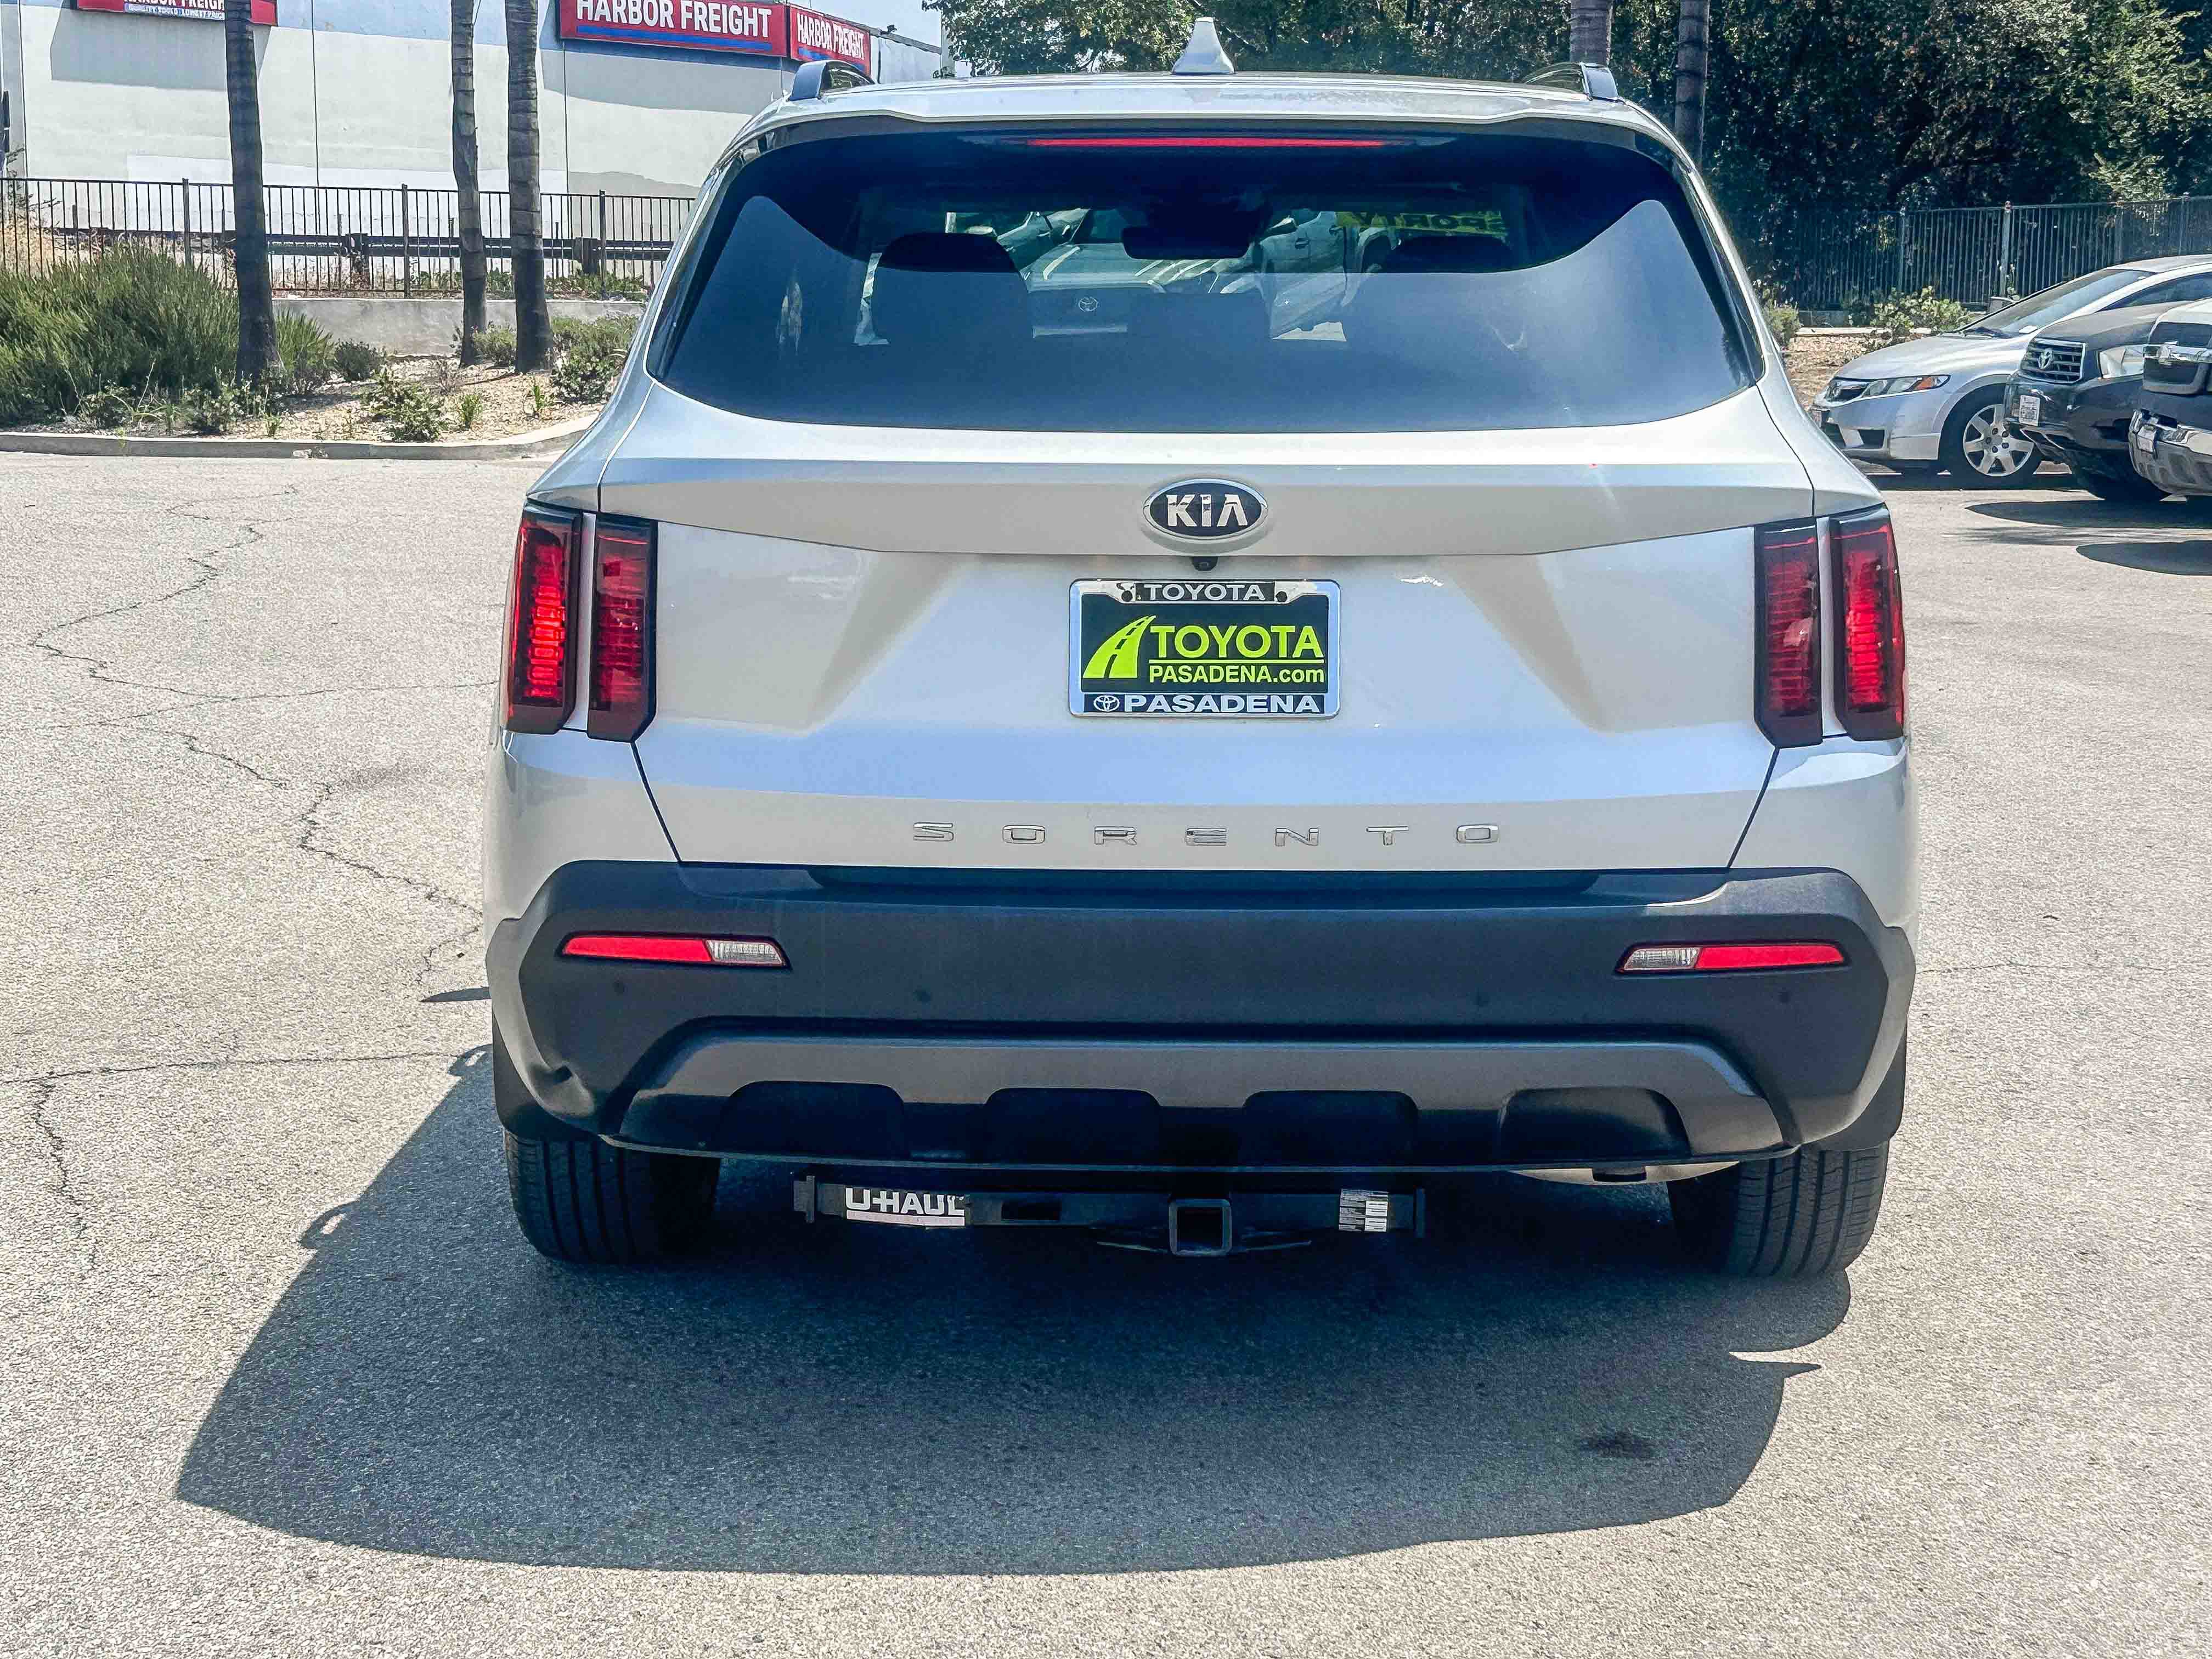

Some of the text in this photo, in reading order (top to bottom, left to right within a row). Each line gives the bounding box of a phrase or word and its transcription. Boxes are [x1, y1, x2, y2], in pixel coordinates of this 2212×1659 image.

[577, 0, 772, 37] HARBOR FREIGHT
[797, 13, 865, 60] HARBOR FREIGHT
[1166, 494, 1249, 527] KIA
[1144, 584, 1265, 601] TOYOTA
[1149, 625, 1325, 658] TOYOTA
[1149, 665, 1325, 684] PASADENA.com
[1124, 694, 1321, 713] PASADENA
[912, 821, 1499, 846] SORENTO
[845, 1187, 965, 1216] U-HAUL
